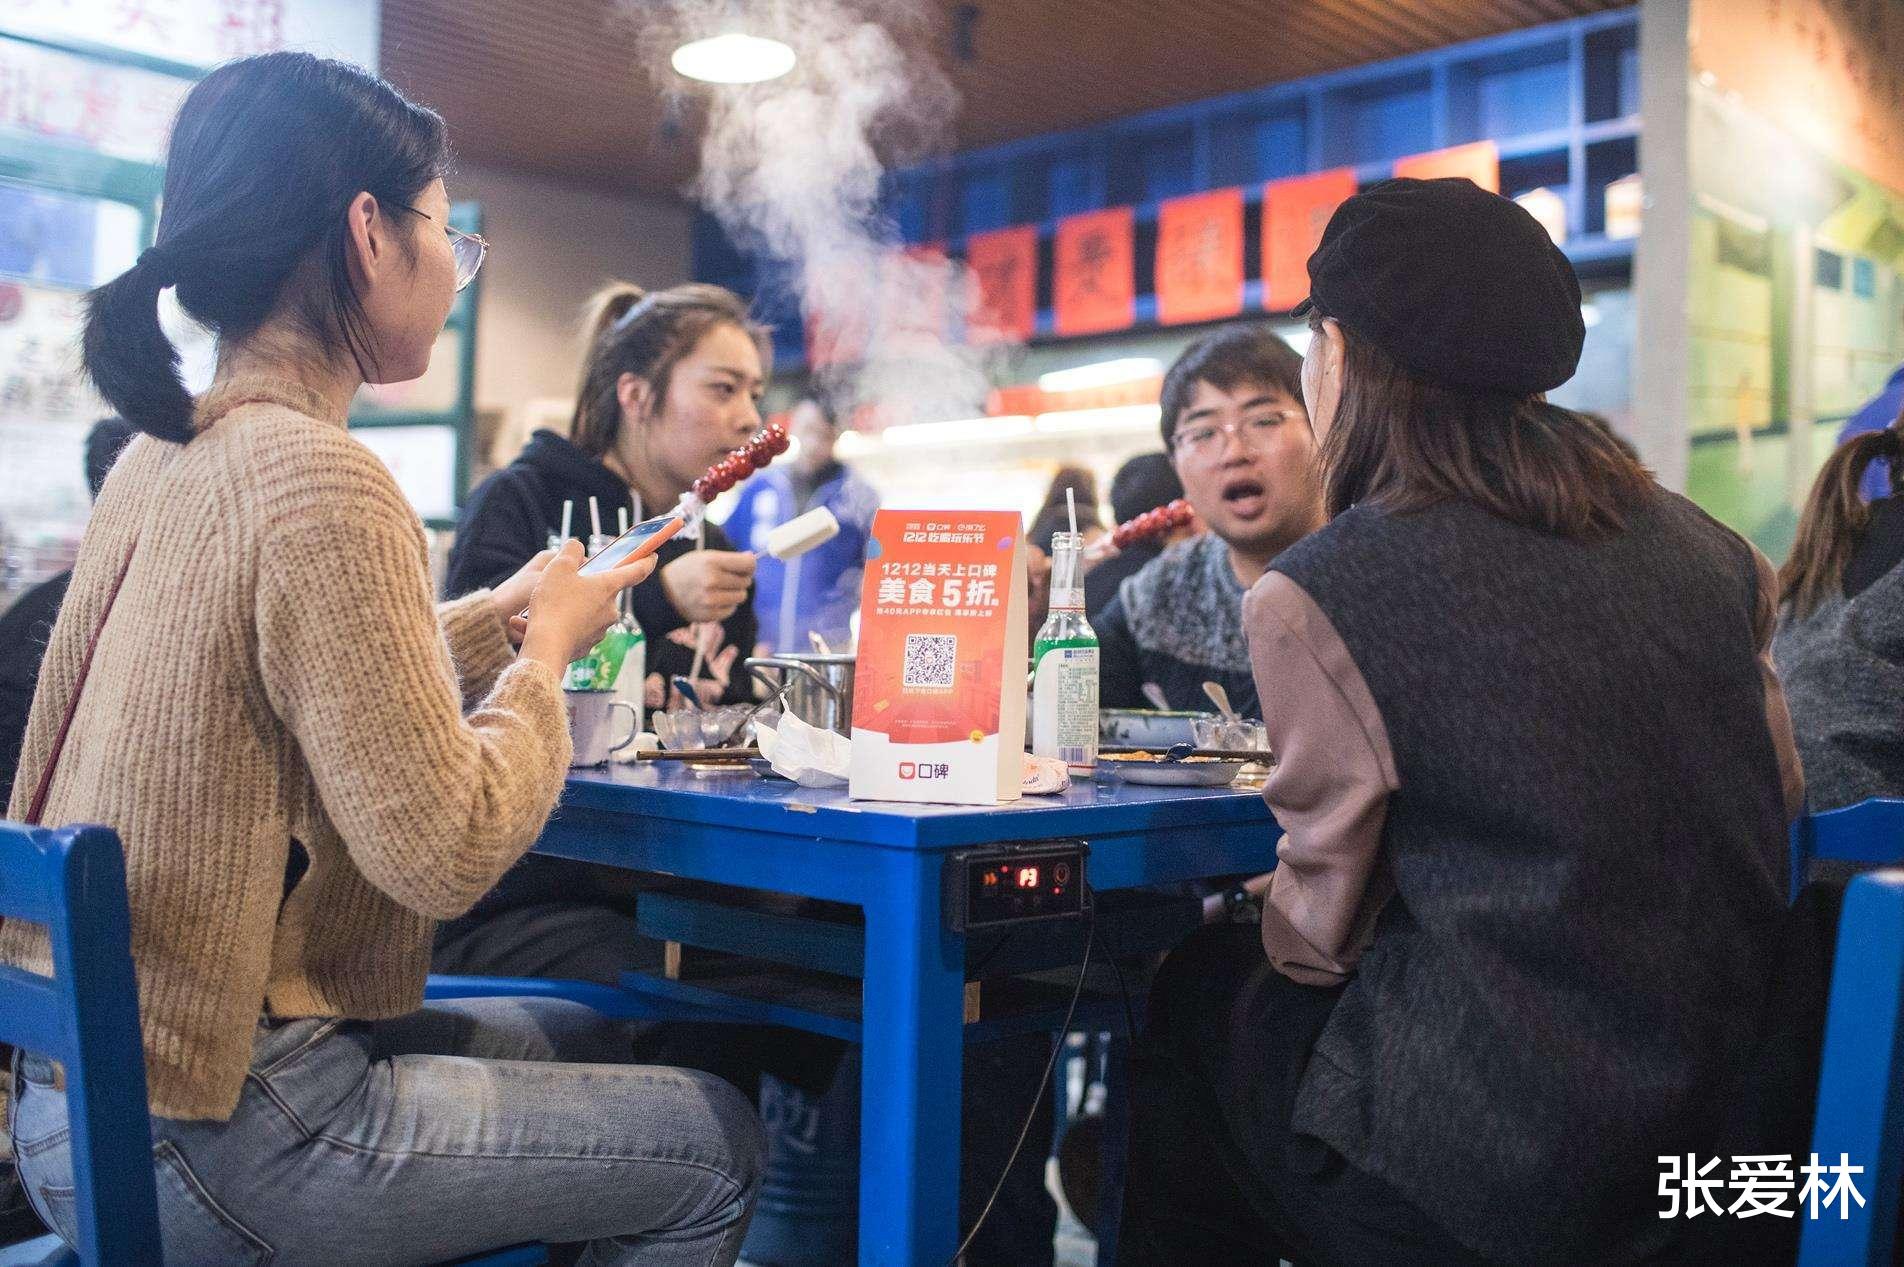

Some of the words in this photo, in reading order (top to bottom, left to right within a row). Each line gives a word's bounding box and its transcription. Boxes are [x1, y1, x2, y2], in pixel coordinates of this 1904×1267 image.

[881, 563, 998, 577] 1212当天上口碑
[877, 577, 1000, 608] 美食5折
[918, 763, 949, 779] 口碑
